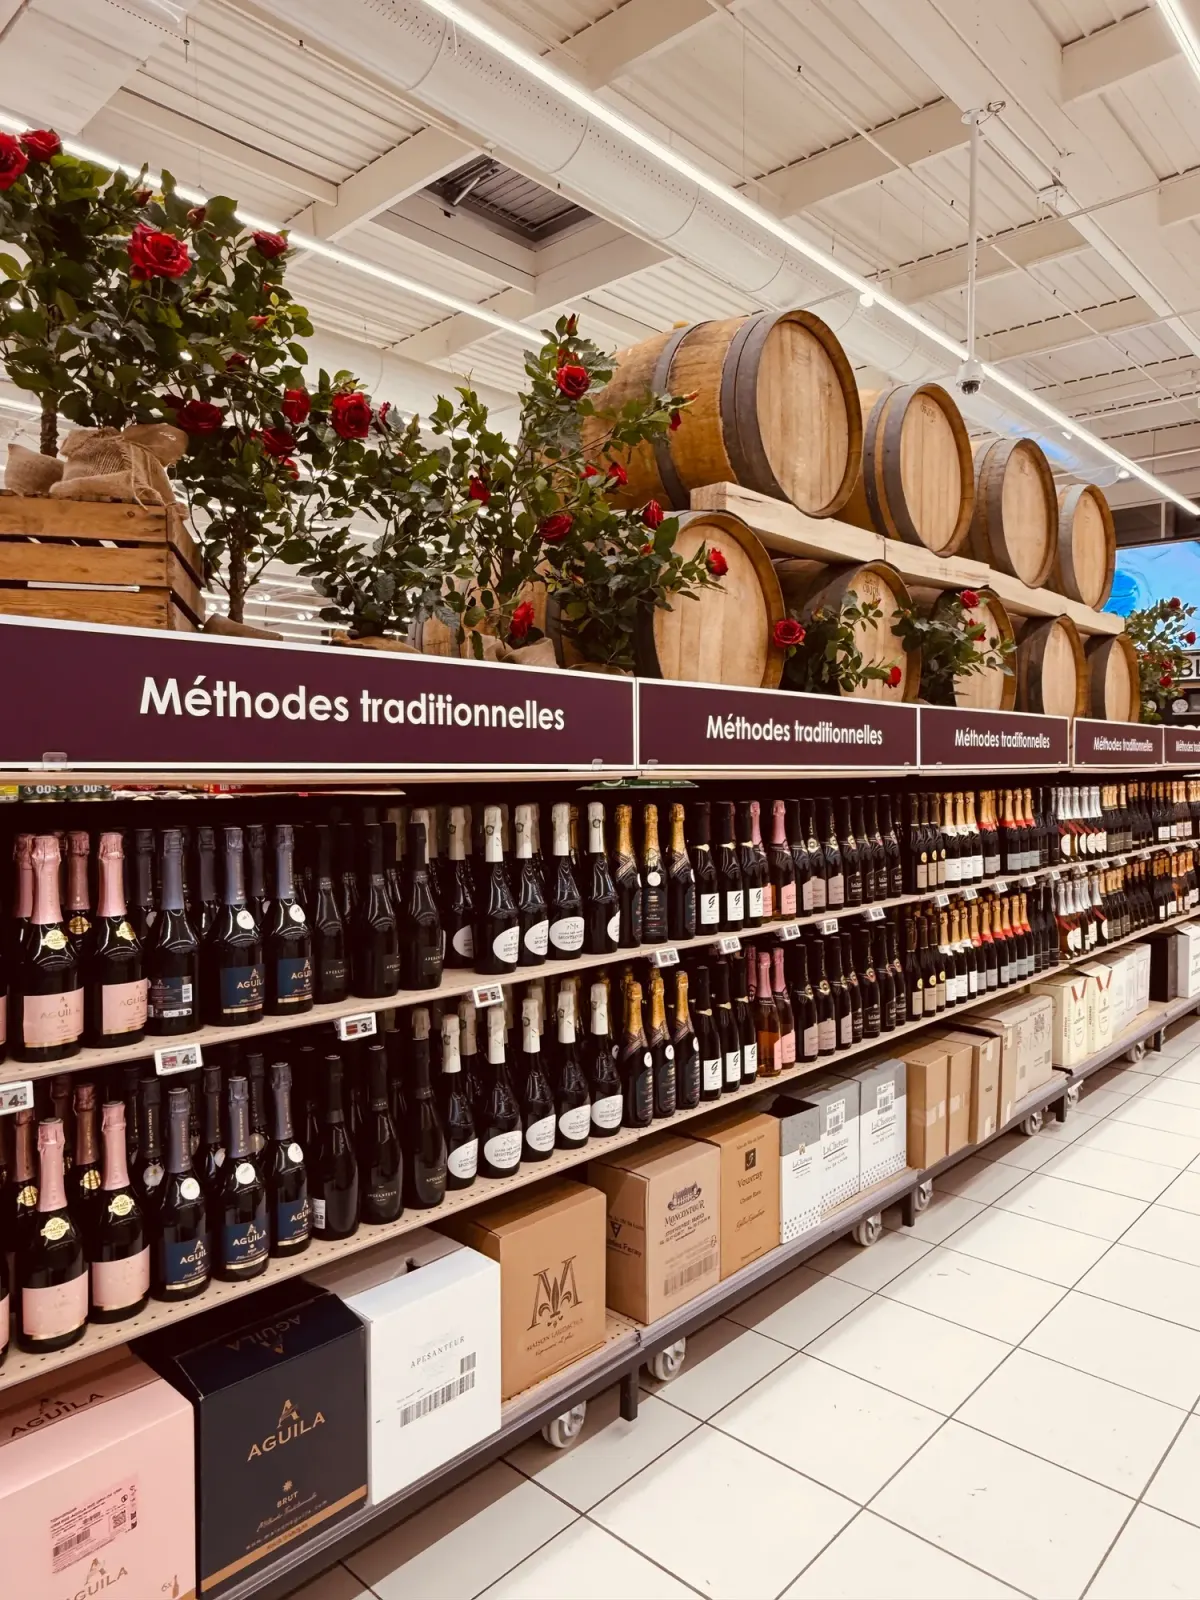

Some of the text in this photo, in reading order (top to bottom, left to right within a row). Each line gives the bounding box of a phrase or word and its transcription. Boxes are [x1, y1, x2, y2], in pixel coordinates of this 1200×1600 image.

[139, 675, 565, 731] Méthodes traditionnelles
[706, 713, 883, 746] Méthodes traditionnelles
[954, 727, 1051, 749] Méthodes traditionnelles
[1093, 736, 1122, 751] Méthodes
[232, 1229, 267, 1247] AGUILA
[179, 1248, 207, 1265] AGUIL
[226, 1314, 301, 1351] AGUILA
[410, 1335, 465, 1369] APESANTEUR
[10, 1393, 105, 1438] AGUILA
[246, 1411, 326, 1462] AGUILA
[276, 1490, 299, 1508] BRUT
[65, 1566, 128, 1600] GUILA
